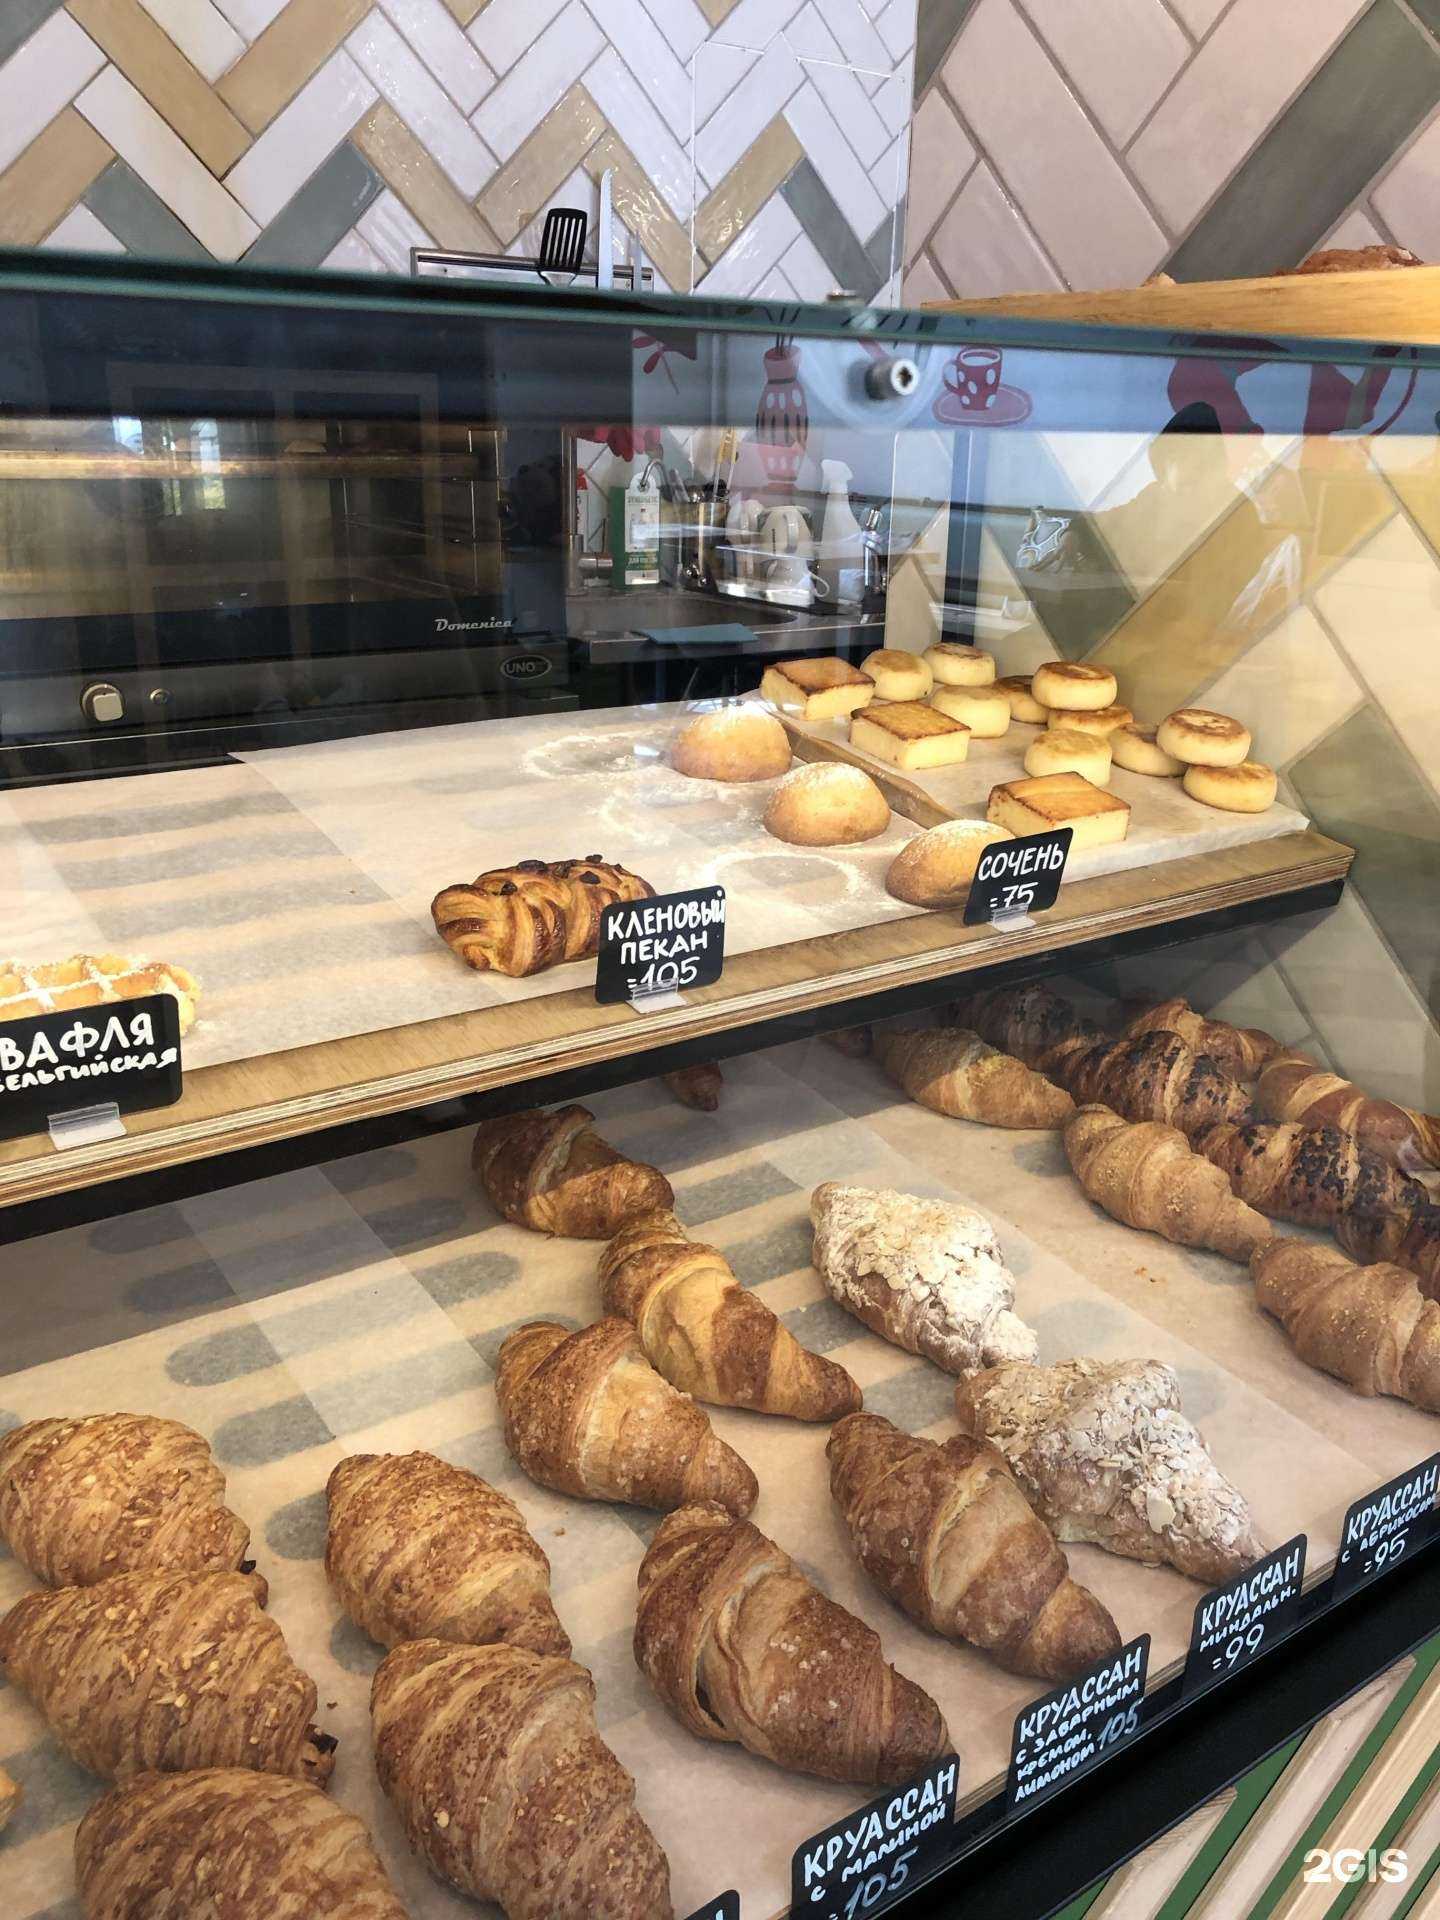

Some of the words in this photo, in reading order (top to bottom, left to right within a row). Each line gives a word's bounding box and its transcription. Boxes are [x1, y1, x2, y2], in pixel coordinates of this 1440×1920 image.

[434, 616, 513, 632] Domenica
[978, 843, 1064, 881] СОЧЕНЬ
[607, 890, 725, 941] КЛЕНОВЫЙ
[620, 930, 708, 965] ПЕКАН
[0, 1012, 155, 1071] ВАФЛЯ
[1346, 1464, 1438, 1545] КРУАССАН
[1200, 1547, 1300, 1636] КРУАССАН
[1019, 1646, 1142, 1744] КРУАССАН
[1097, 1697, 1144, 1750] 105
[804, 1763, 957, 1887] КРУАССАН
